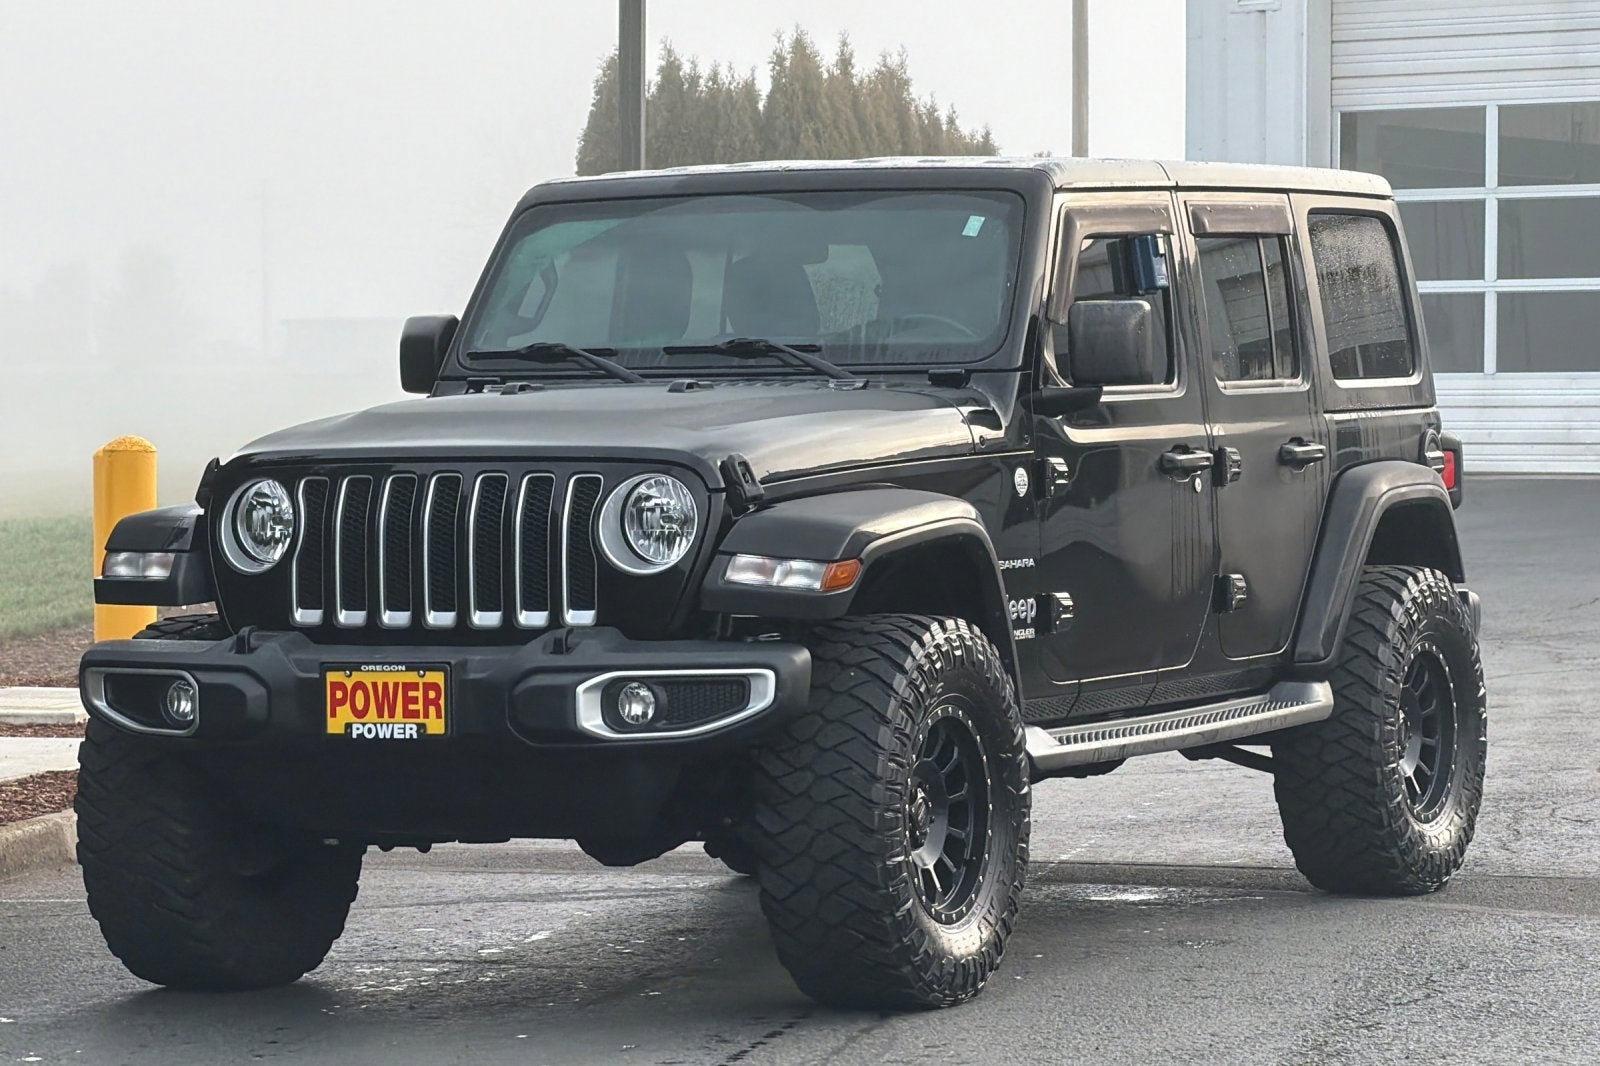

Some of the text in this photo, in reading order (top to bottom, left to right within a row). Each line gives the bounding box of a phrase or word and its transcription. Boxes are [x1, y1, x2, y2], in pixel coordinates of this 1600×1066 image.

[998, 558, 1036, 570] SAHARA
[1008, 598, 1037, 624] eep
[1013, 628, 1036, 636] NGLER
[329, 681, 443, 720] POWER
[351, 723, 418, 739] POWER
